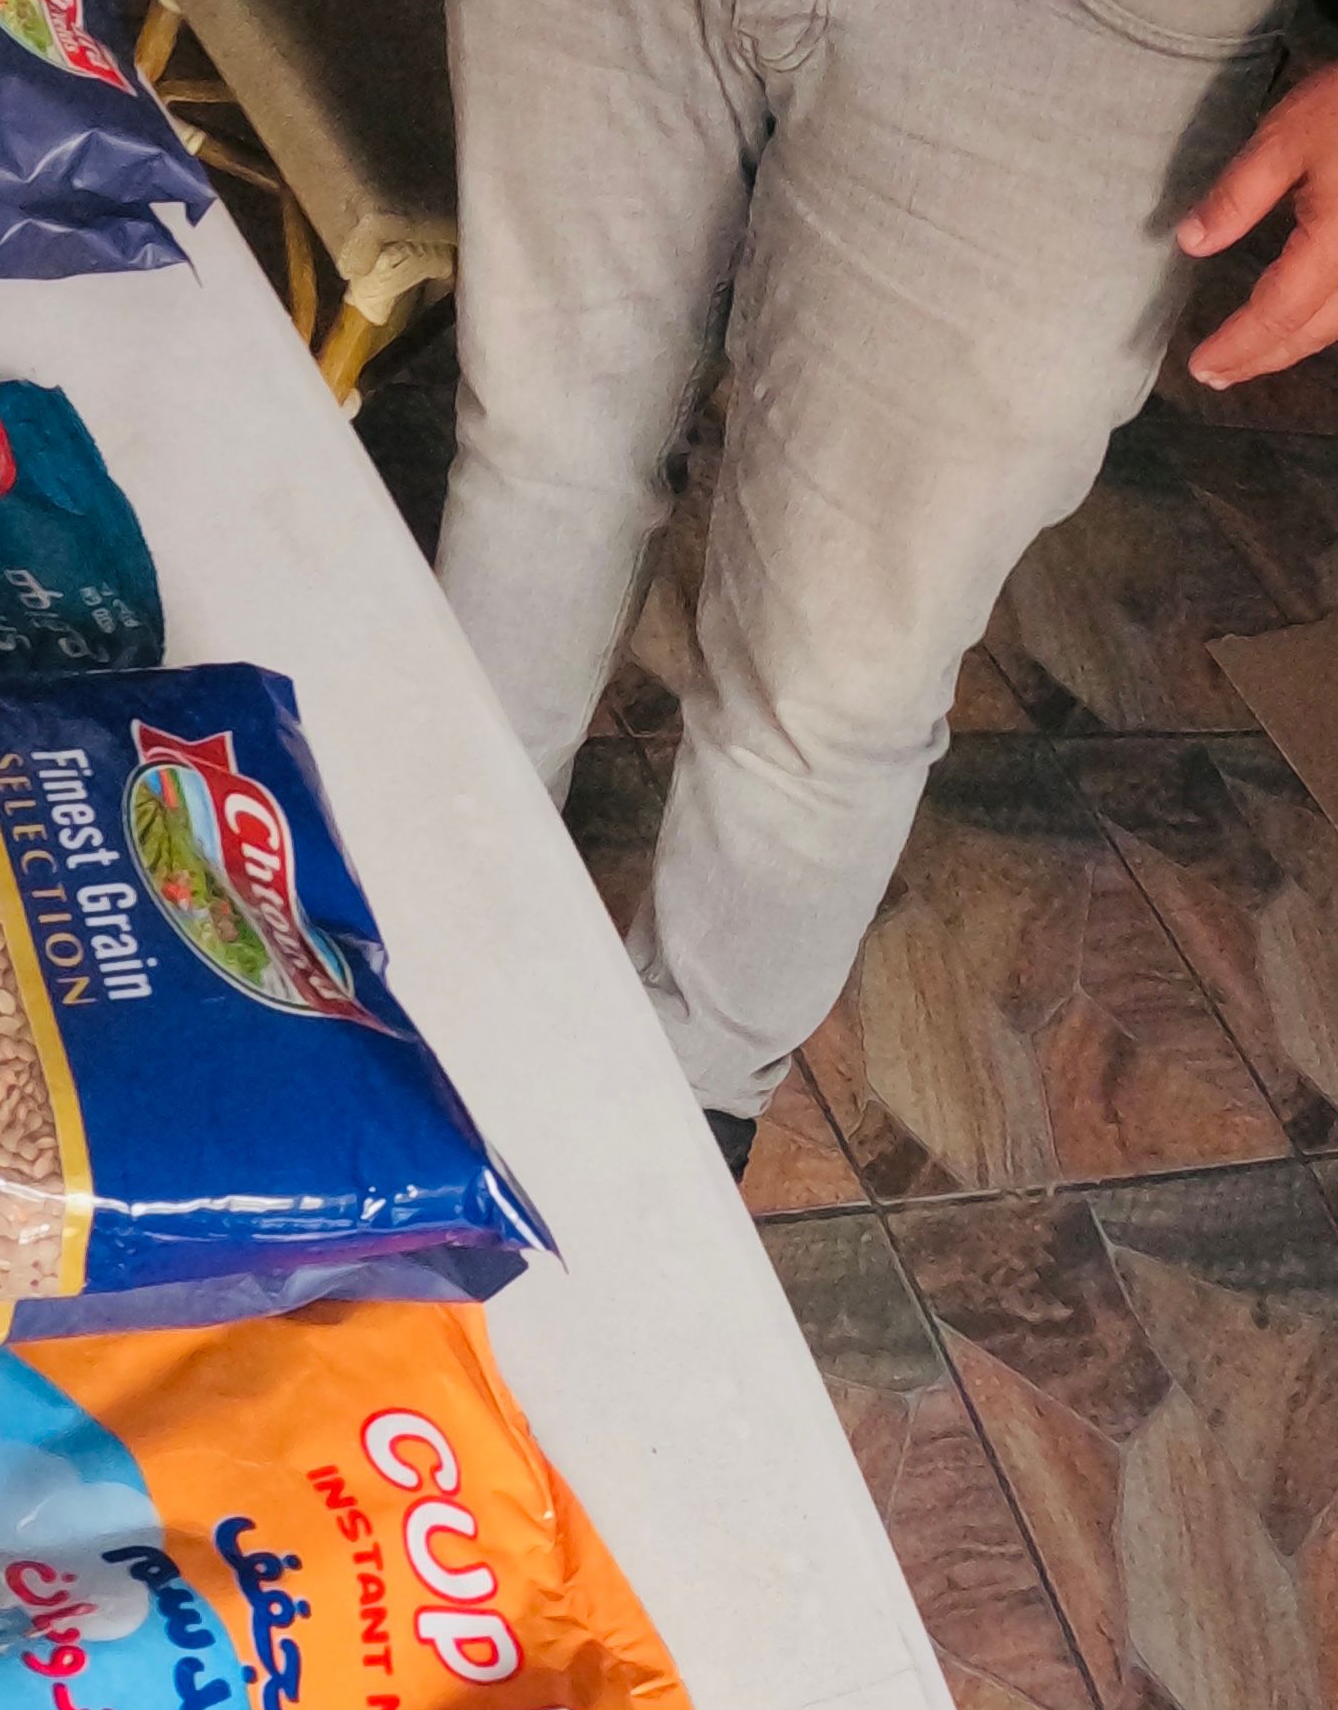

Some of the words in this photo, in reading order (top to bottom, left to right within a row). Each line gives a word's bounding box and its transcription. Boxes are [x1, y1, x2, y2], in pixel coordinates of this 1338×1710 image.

[30, 746, 121, 870] Finest
[75, 882, 155, 1002] Grain
[306, 1463, 397, 1679] INSTANT
[361, 1407, 523, 1684] CUP
